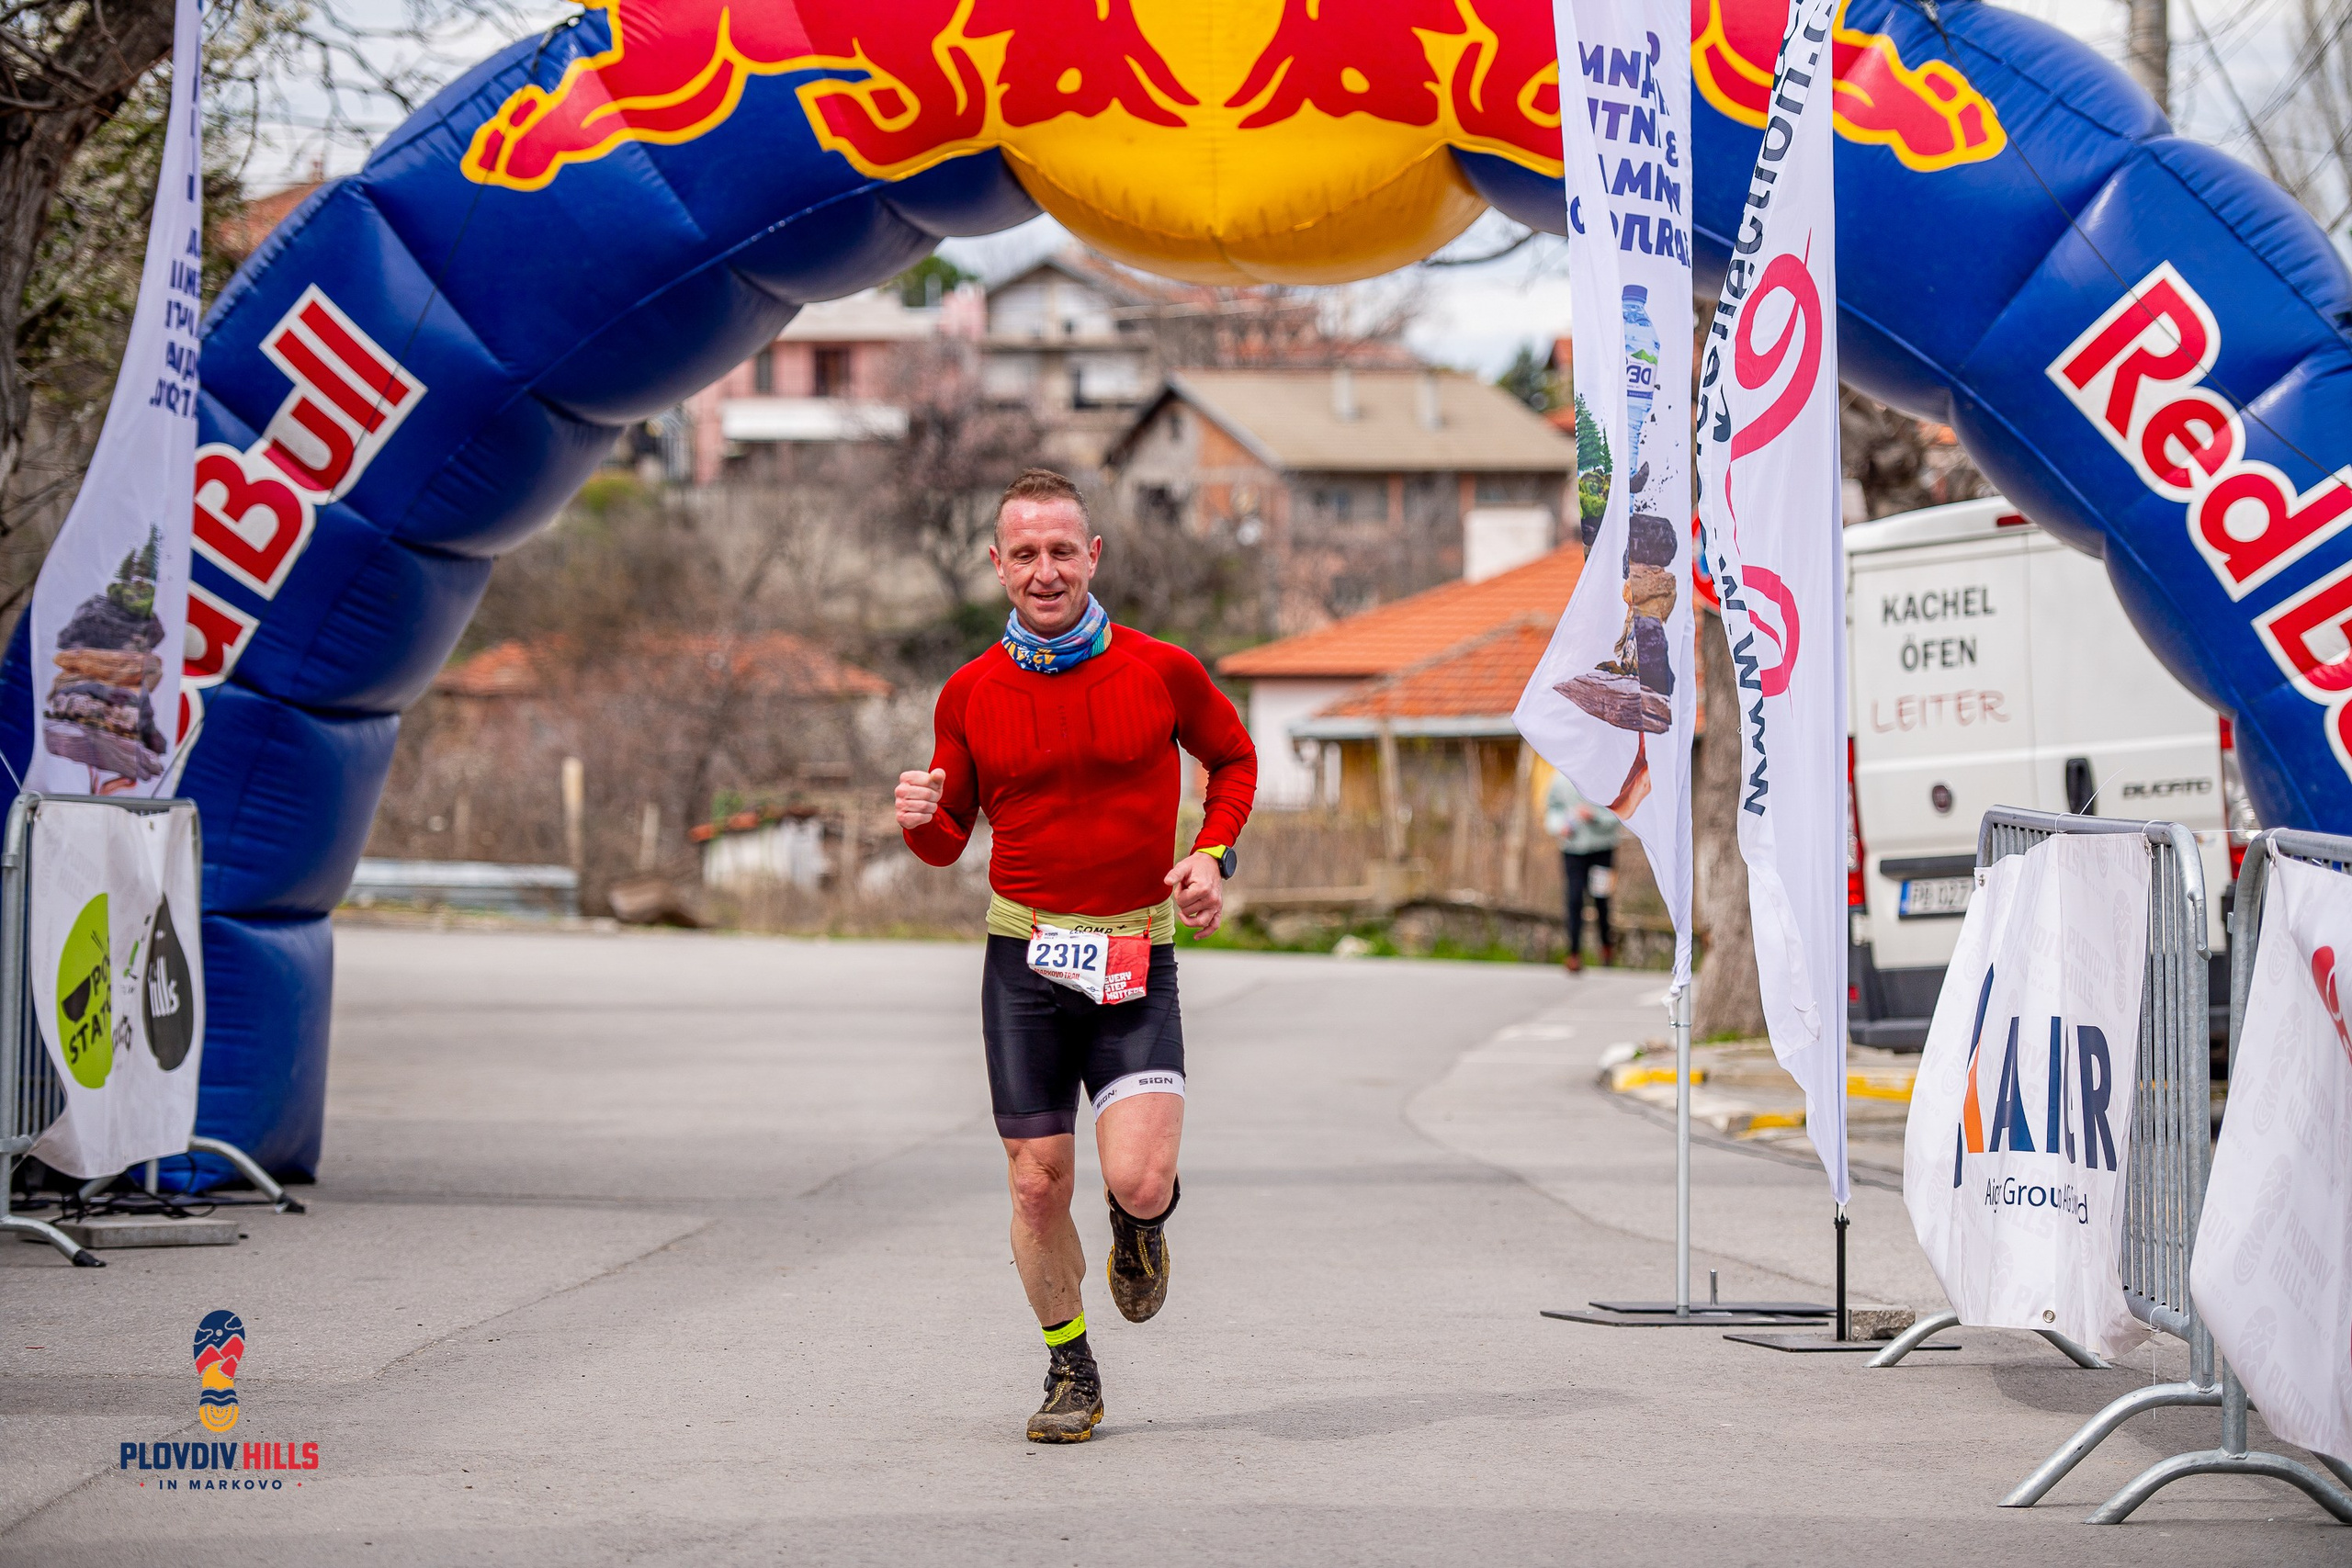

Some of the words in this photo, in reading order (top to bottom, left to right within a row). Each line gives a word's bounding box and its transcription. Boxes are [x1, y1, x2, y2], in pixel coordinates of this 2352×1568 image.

[2062, 276, 2352, 585] Red
[1882, 586, 1996, 626] KACHEL
[1900, 635, 1978, 672] ÖFEN
[1871, 689, 2011, 733] LEITER
[1035, 943, 1098, 972] 2312
[1105, 971, 1132, 984] EVERY
[1105, 981, 1126, 993] STEP
